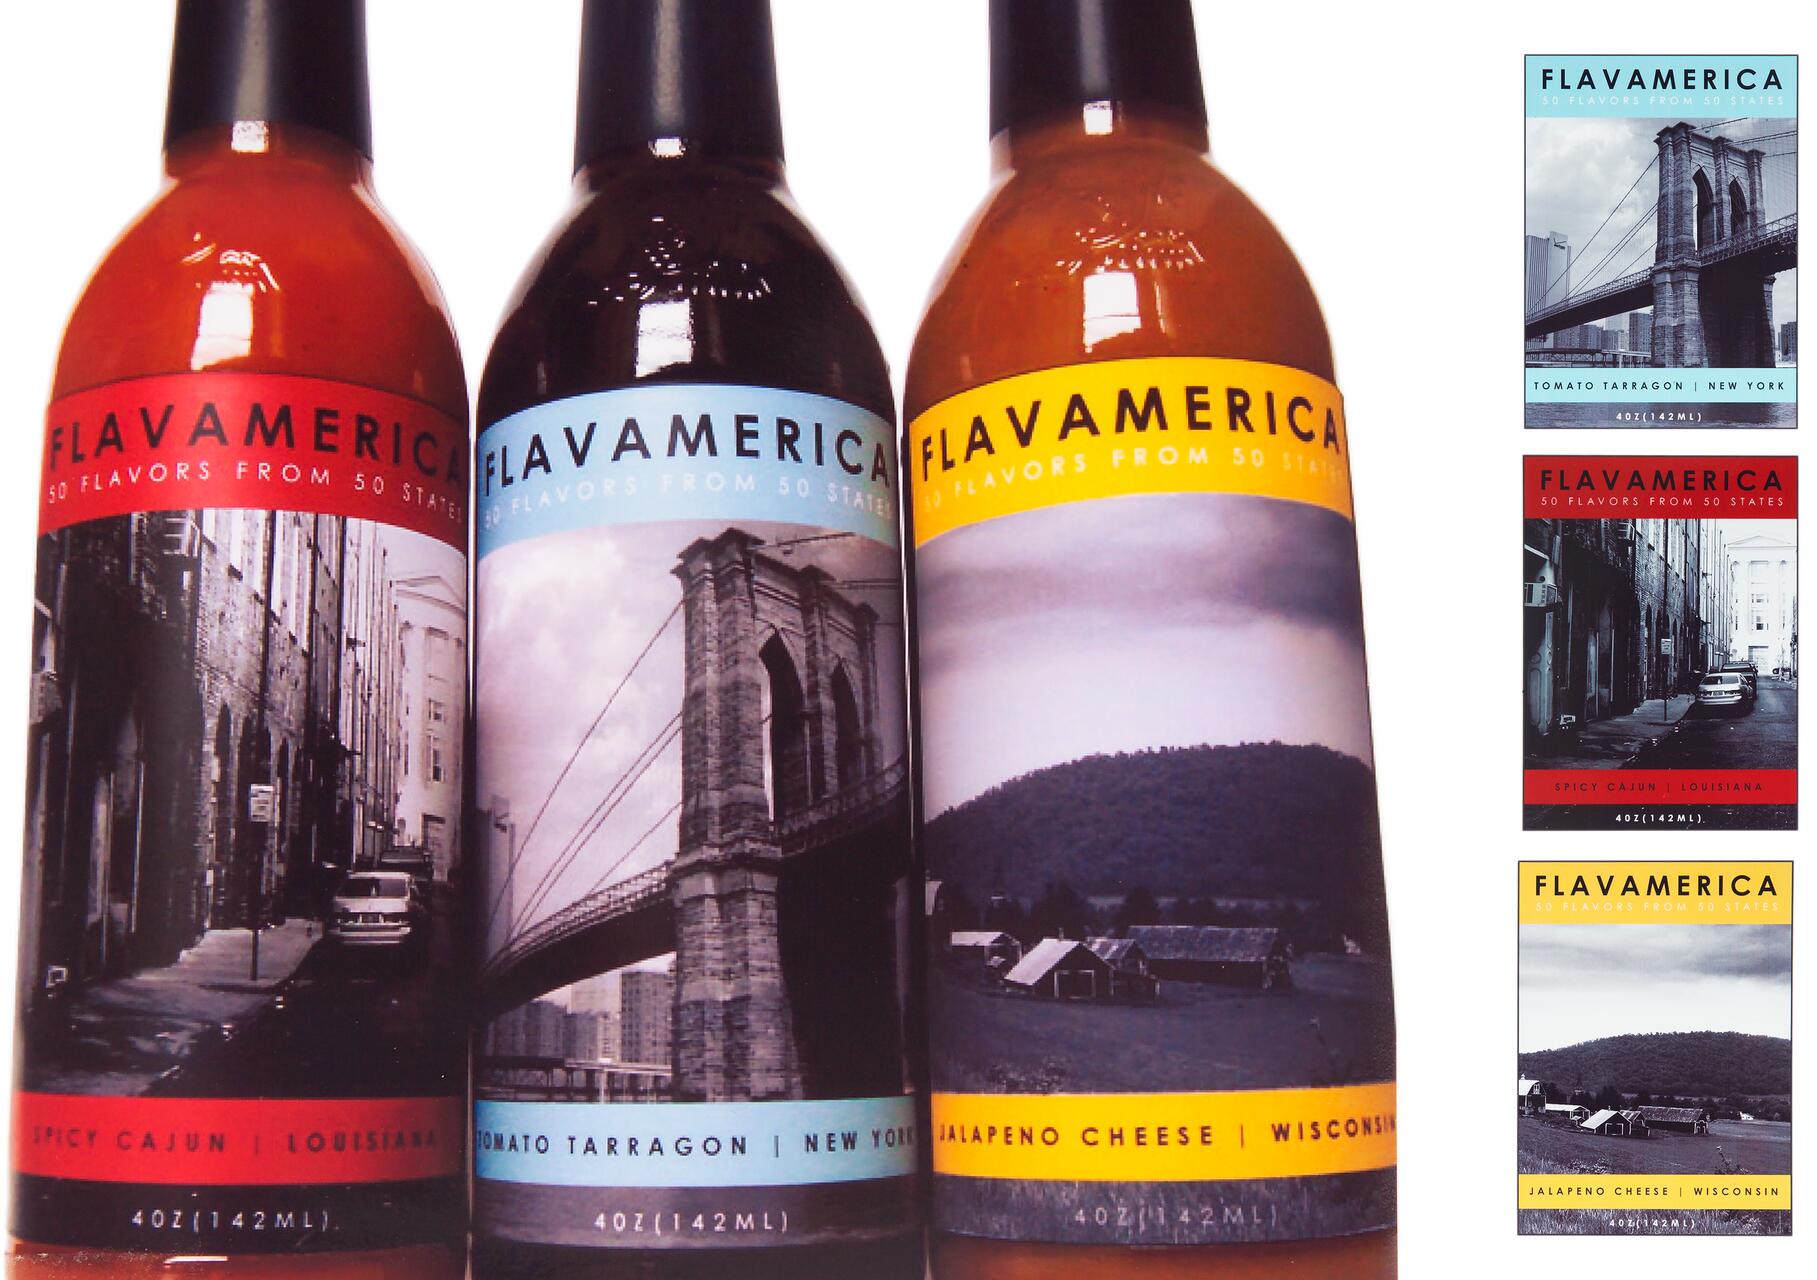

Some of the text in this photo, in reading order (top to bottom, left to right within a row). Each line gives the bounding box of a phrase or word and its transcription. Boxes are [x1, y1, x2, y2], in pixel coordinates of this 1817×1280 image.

[1541, 68, 1783, 90] FLAVAMERICA
[1541, 95, 1784, 106] 50 FLAVORS FROM 50 STATES
[1533, 381, 1785, 391] TOMATO TARRAGON NEW YORK
[50, 401, 461, 484] FLAVAMERICA
[922, 385, 1340, 482] FLAVAMERICA
[484, 414, 891, 497] FLAVAMERICA
[48, 481, 68, 504] 50
[79, 461, 212, 493] FLAVORS
[236, 460, 332, 486] FROM
[353, 472, 386, 496] 50
[954, 453, 1088, 499] FLAVORS
[1111, 446, 1209, 469] FROM
[1232, 446, 1265, 468] 50
[1540, 469, 1783, 491] FLAVAMERICA
[511, 478, 638, 516] FLAVORS
[661, 471, 757, 495] FROM
[778, 477, 811, 499] 50
[1541, 496, 1784, 506] 50 FLAVORS FROM 50 STATES
[1554, 782, 1763, 792] SPICY CAJUN LOUISIANA
[1535, 874, 1778, 896] FLAVAMERICA
[1535, 901, 1779, 912] 50 FLAVORS FROM 50 STATES
[33, 1126, 436, 1153] SPICY CAJUN LOUISIANA
[567, 1134, 748, 1157] TARRAGON
[803, 1131, 859, 1154] NEW
[939, 1123, 1060, 1147] JALAPENO
[1081, 1124, 1214, 1148] CHEESE
[1528, 1187, 1780, 1197] JALAPENO CHEESE WISCONSIN
